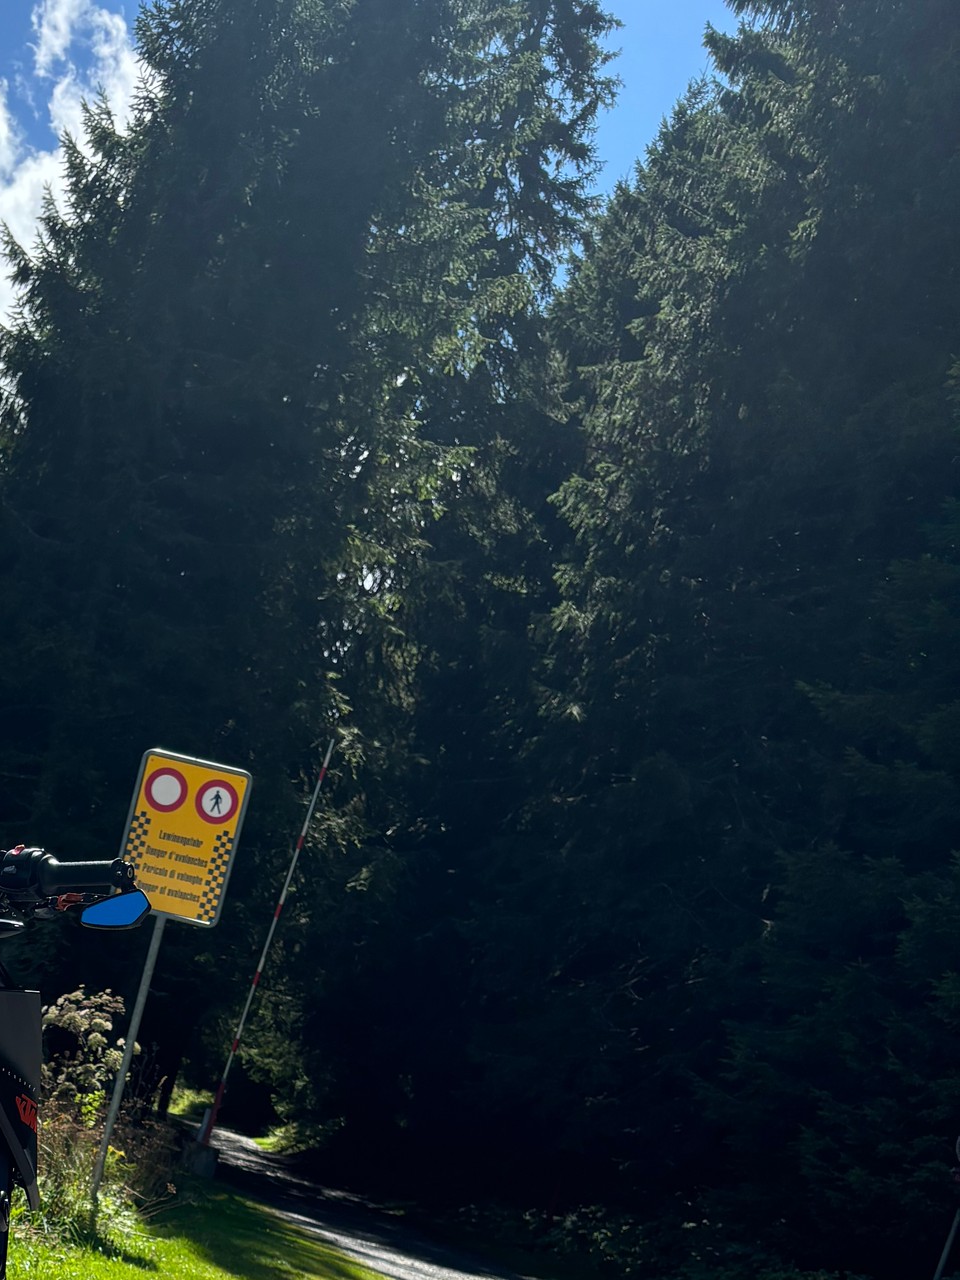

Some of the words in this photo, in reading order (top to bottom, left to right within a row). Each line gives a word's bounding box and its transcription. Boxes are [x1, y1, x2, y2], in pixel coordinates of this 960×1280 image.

[145, 845, 167, 859] Danger
[168, 850, 208, 868] d'avalanches
[169, 869, 176, 878] di
[159, 886, 167, 895] of
[167, 888, 200, 903] avalanches
[15, 1093, 38, 1134] KTM
